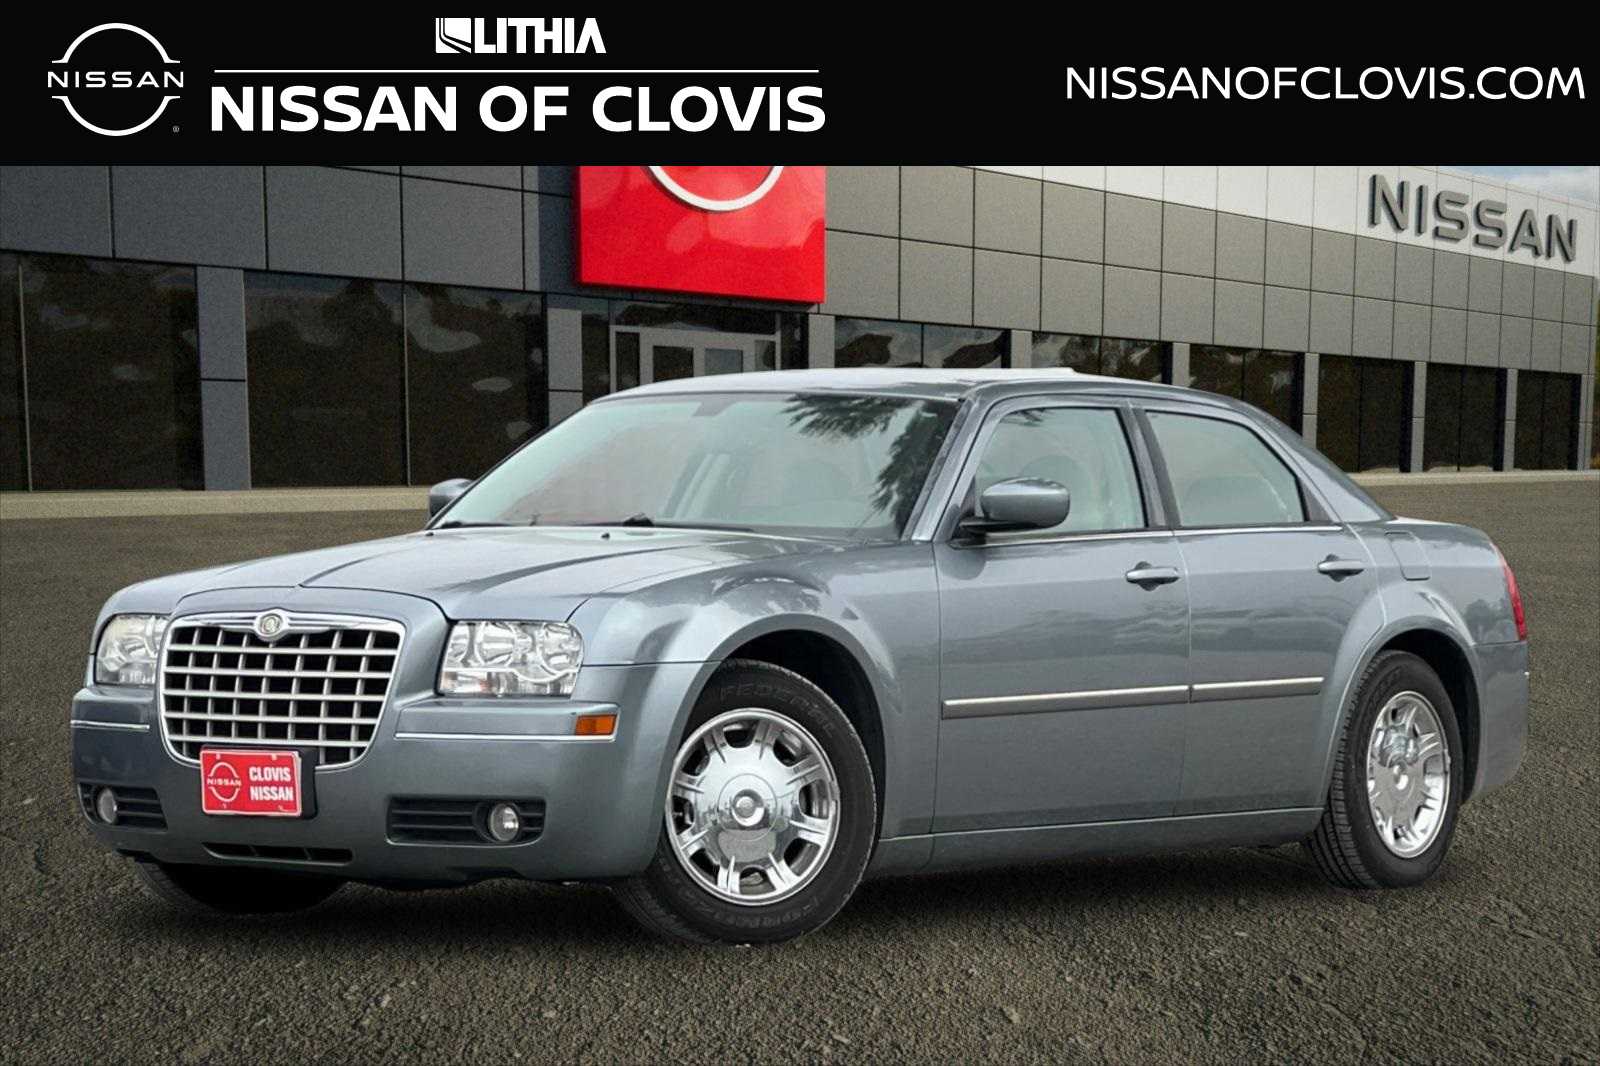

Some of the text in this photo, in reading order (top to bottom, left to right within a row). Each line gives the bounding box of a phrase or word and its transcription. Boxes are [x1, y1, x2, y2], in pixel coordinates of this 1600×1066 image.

[1368, 174, 1577, 263] NISSAN
[207, 778, 242, 786] NISSAN
[249, 766, 291, 782] CLOVIS
[250, 785, 294, 801] NISSAN
